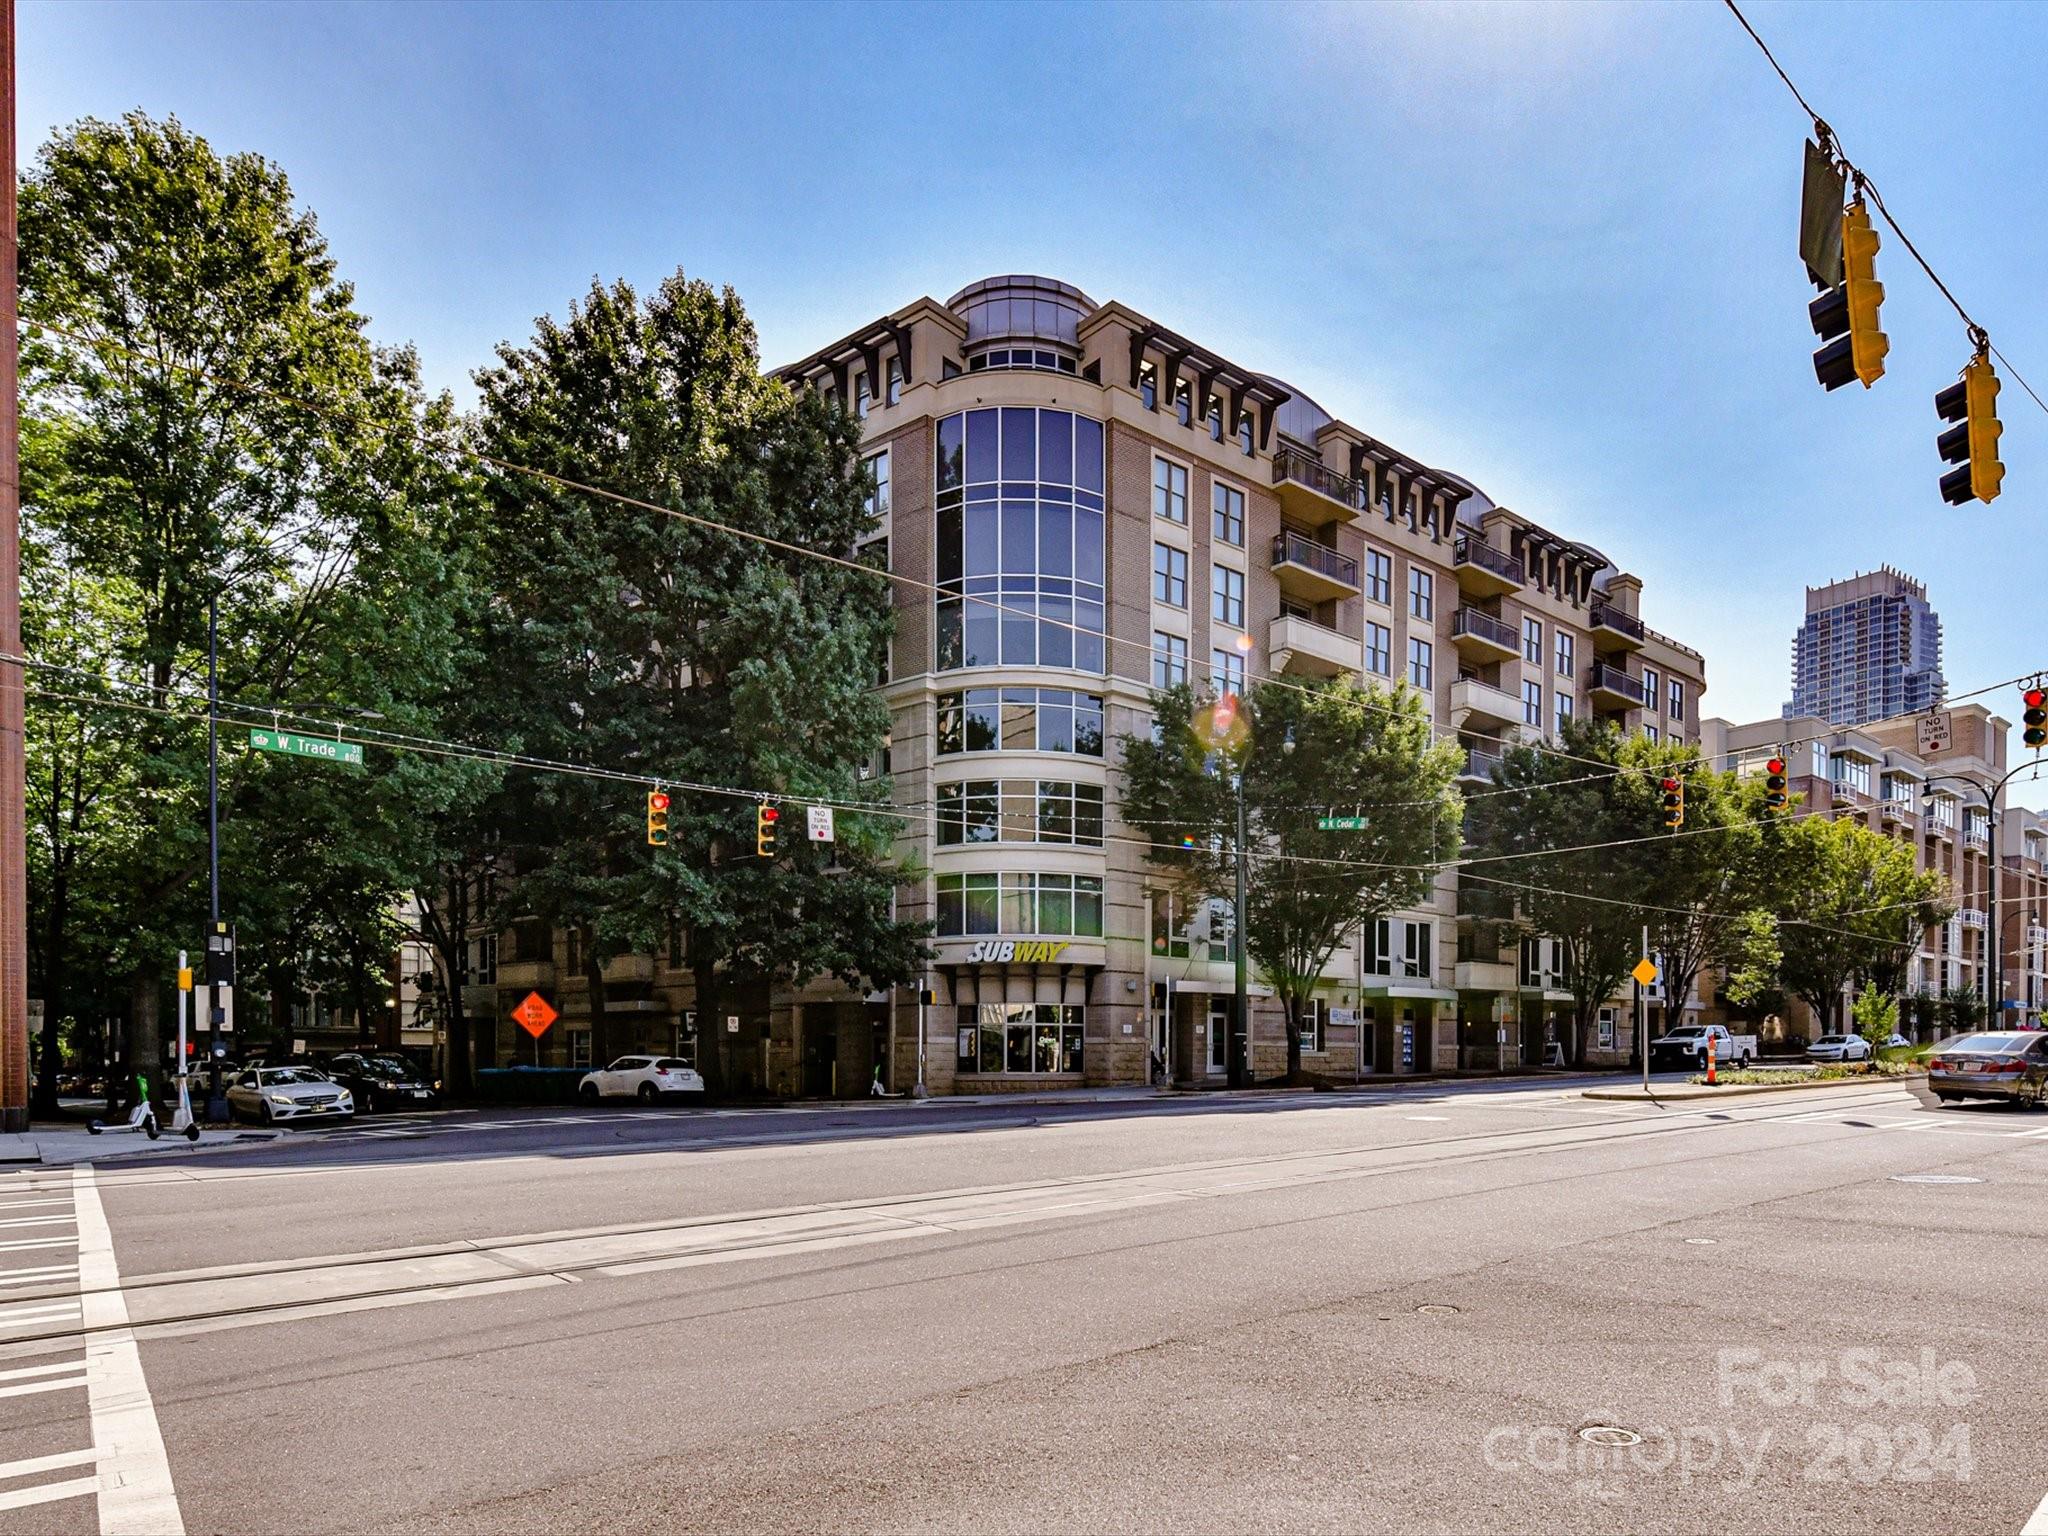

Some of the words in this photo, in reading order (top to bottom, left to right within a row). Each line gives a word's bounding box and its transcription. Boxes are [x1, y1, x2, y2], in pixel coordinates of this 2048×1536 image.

[1925, 717, 1940, 727] NO
[1924, 725, 1944, 735] TURN
[1933, 732, 1948, 740] RED
[277, 735, 292, 750] W.
[298, 738, 336, 757] Trade
[1336, 819, 1355, 829] Cedar
[966, 941, 1069, 963] SUBWAY
